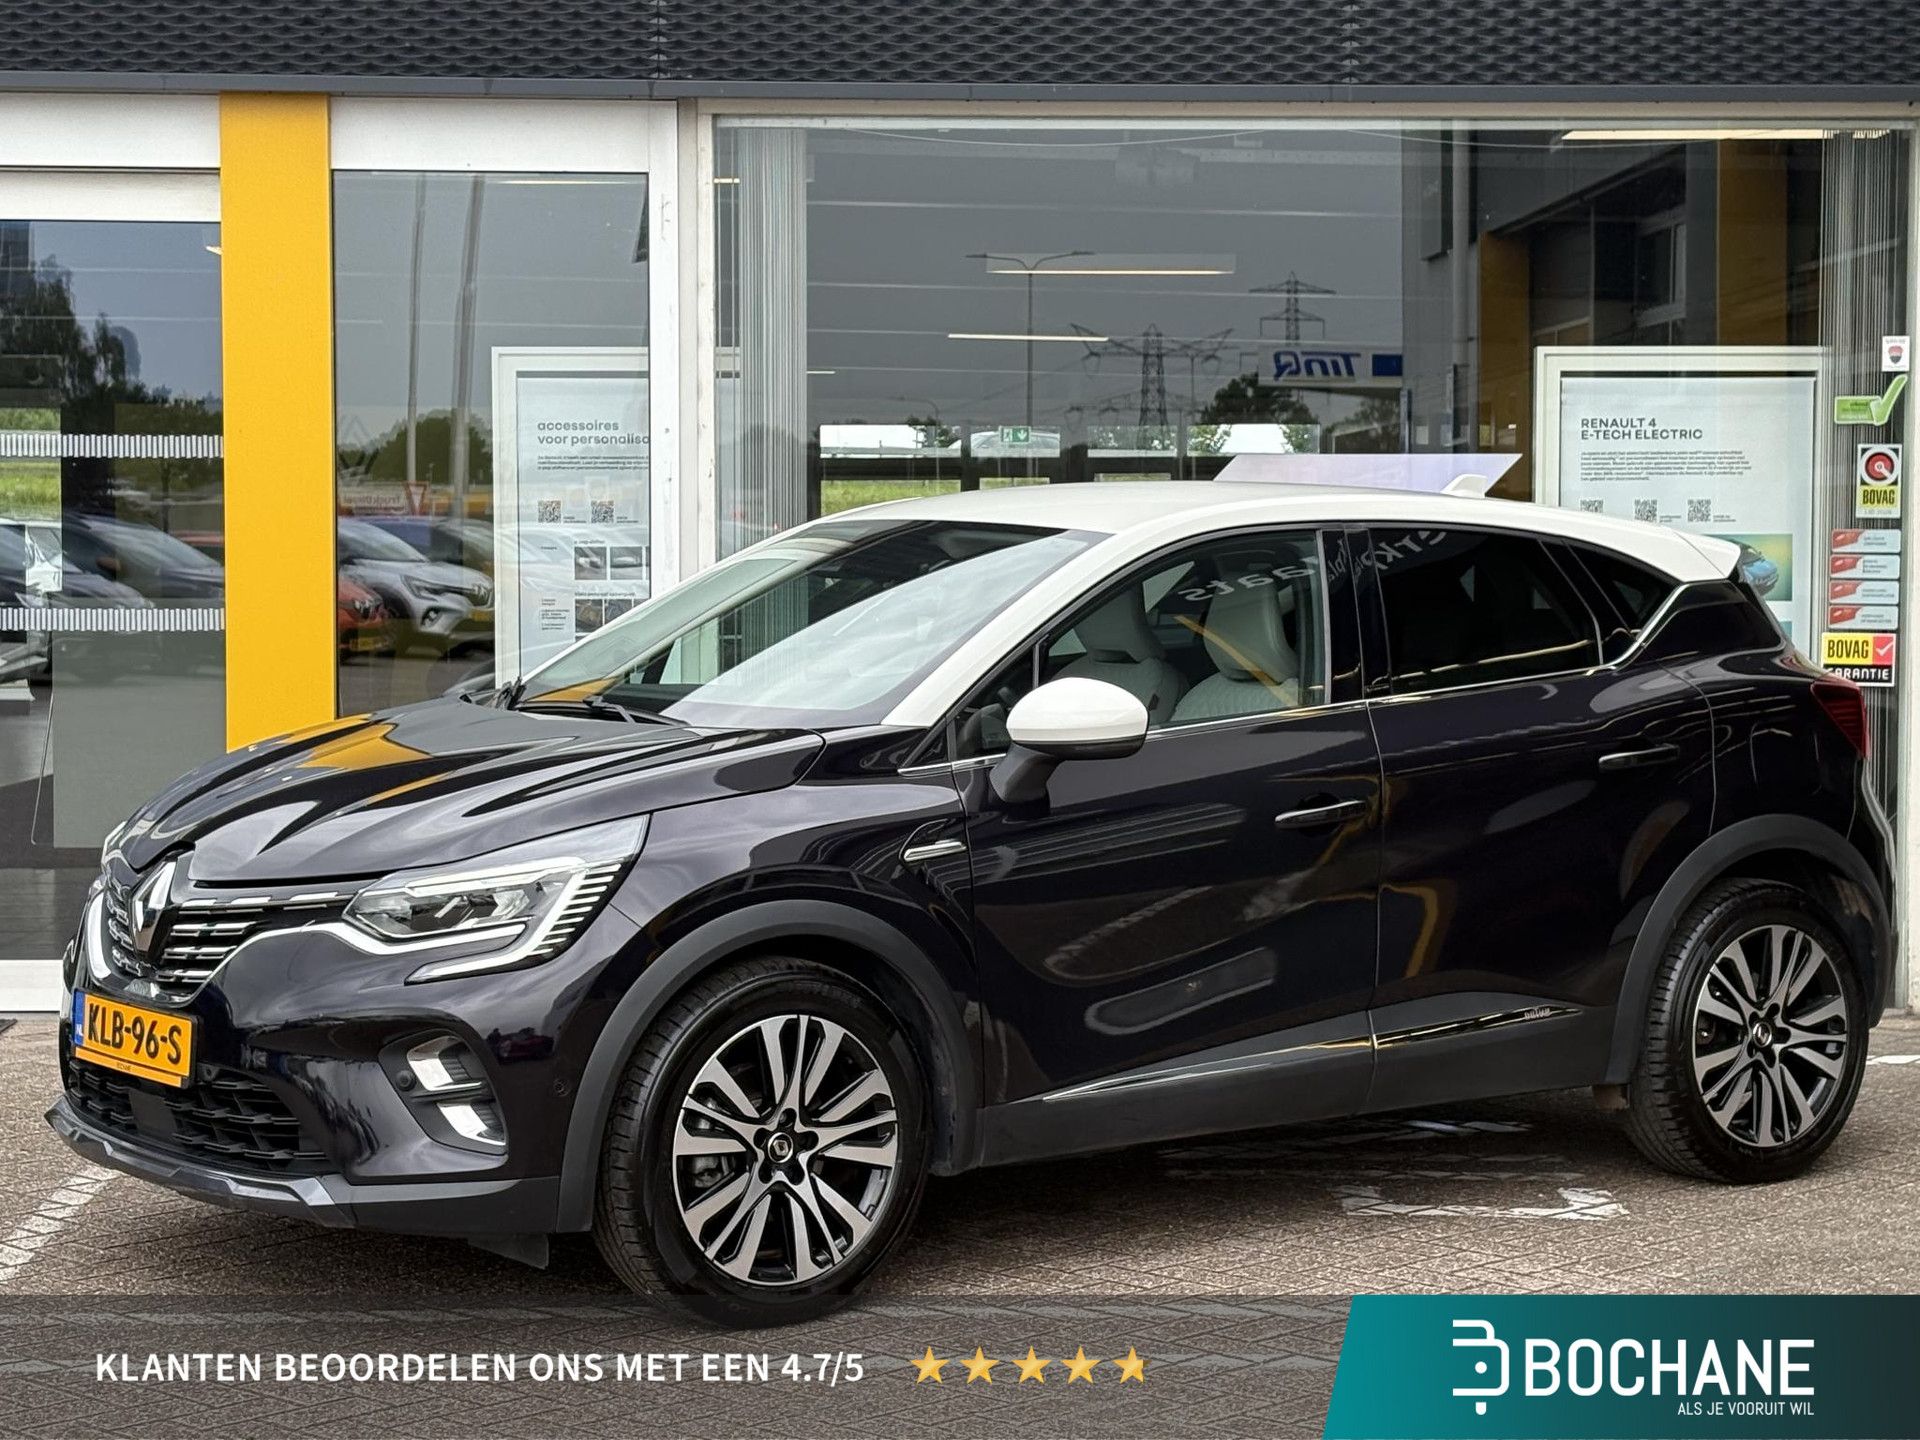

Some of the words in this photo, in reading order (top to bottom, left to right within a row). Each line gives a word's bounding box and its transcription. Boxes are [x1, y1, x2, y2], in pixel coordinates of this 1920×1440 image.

[537, 420, 619, 431] accessoires
[1581, 417, 1645, 429] RENAULT
[1648, 417, 1657, 428] 4
[537, 434, 568, 445] voor
[1581, 429, 1632, 440] E-TECH
[1635, 429, 1703, 440] ELECTRIC
[1862, 489, 1896, 505] BOVAG
[1827, 639, 1869, 659] BOVAG
[1826, 667, 1890, 681] ARANTIE
[88, 1003, 182, 1065] KLB-96-S
